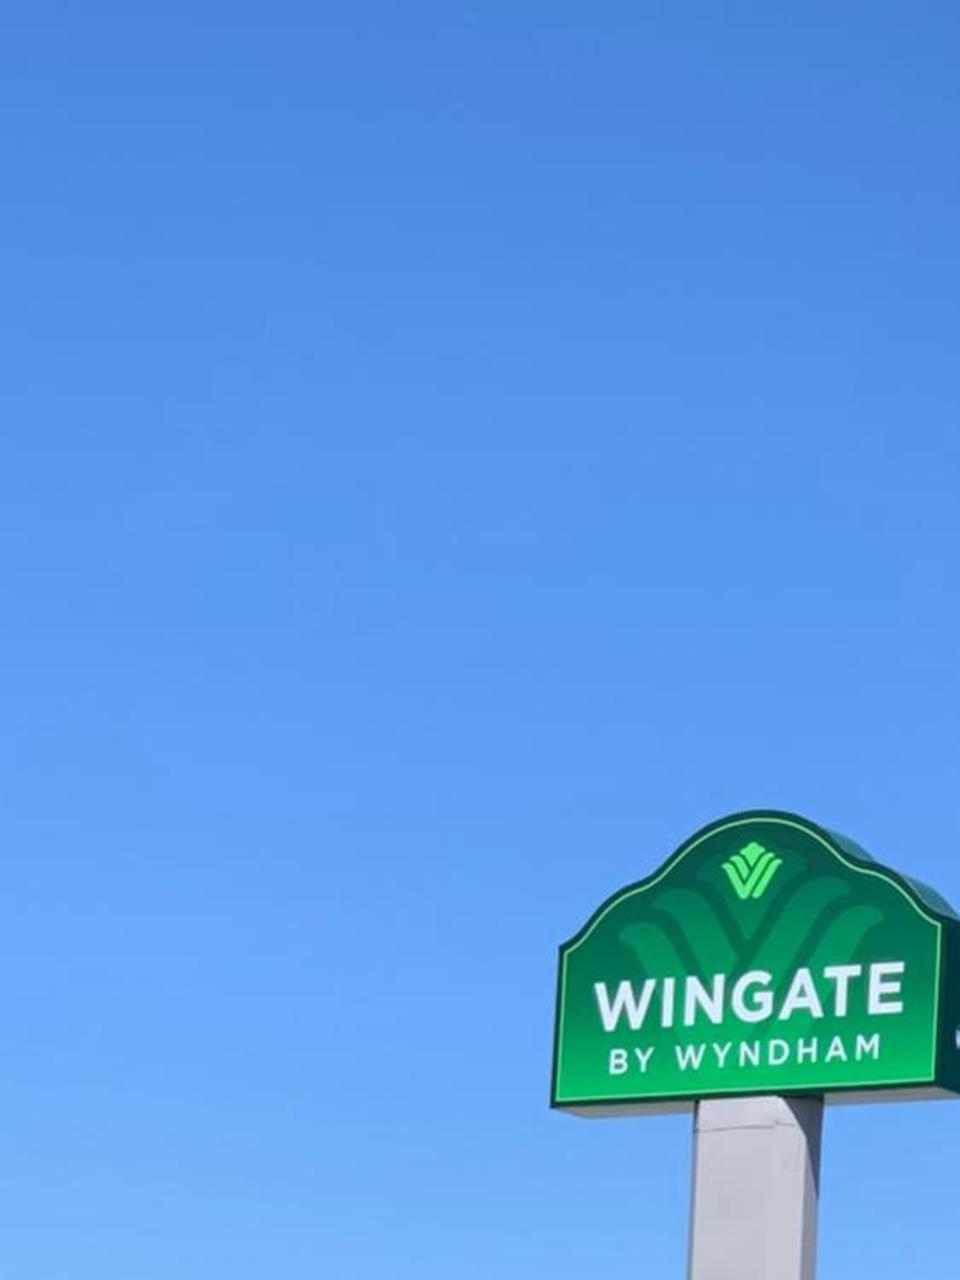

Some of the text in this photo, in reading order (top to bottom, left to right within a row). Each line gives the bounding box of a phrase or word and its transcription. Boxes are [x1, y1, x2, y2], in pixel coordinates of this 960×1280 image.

[594, 961, 905, 1032] WINGATE
[608, 1033, 880, 1075] BY WYNDHAM
